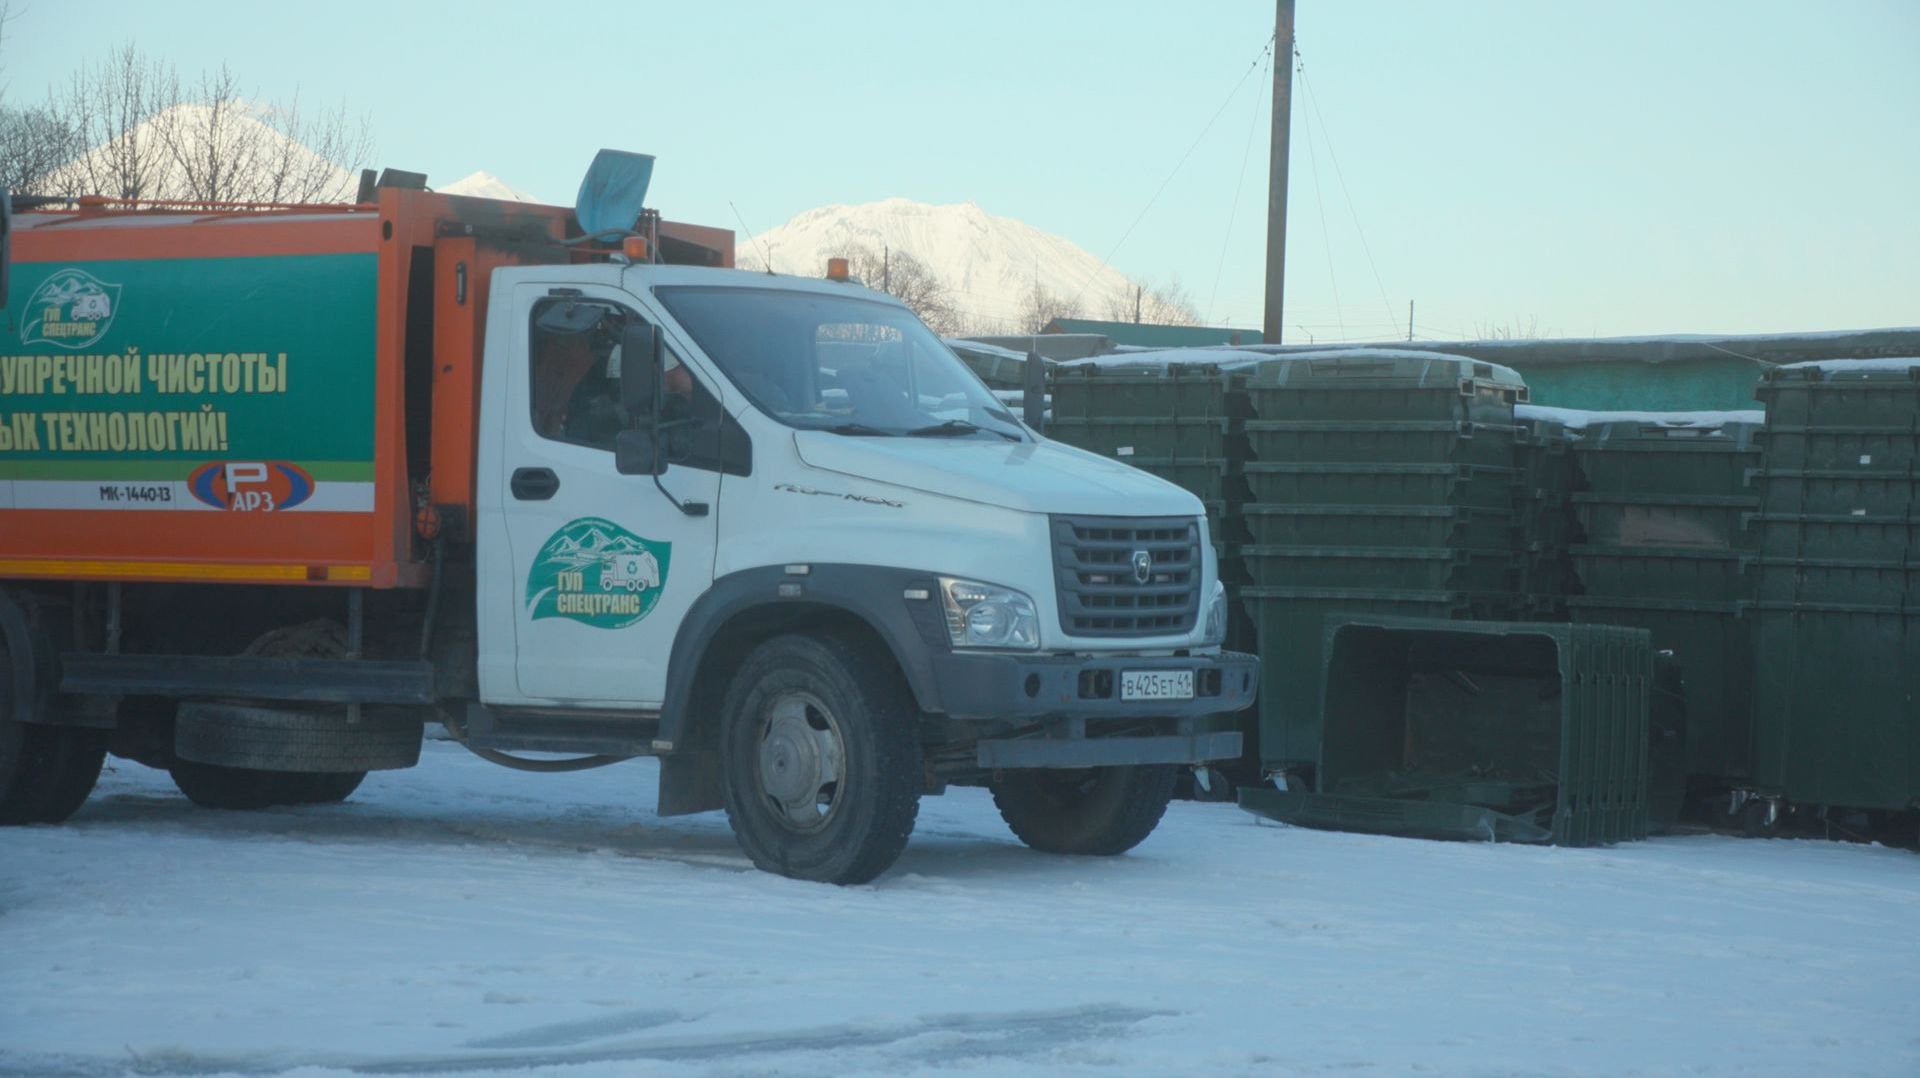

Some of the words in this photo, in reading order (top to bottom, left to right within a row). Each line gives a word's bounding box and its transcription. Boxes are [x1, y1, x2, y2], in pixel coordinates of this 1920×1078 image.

[42, 322, 97, 337] СПЕЦТРАНС
[1, 346, 141, 394] УПРЕЧНОЙ
[148, 353, 287, 393] ЧИСТОТЫ
[0, 412, 40, 450] ЫХ
[43, 404, 228, 451] ТЕХНОЛОГИЙ!
[557, 572, 583, 591] ГУП
[557, 594, 641, 616] СПЕЦТРАНС
